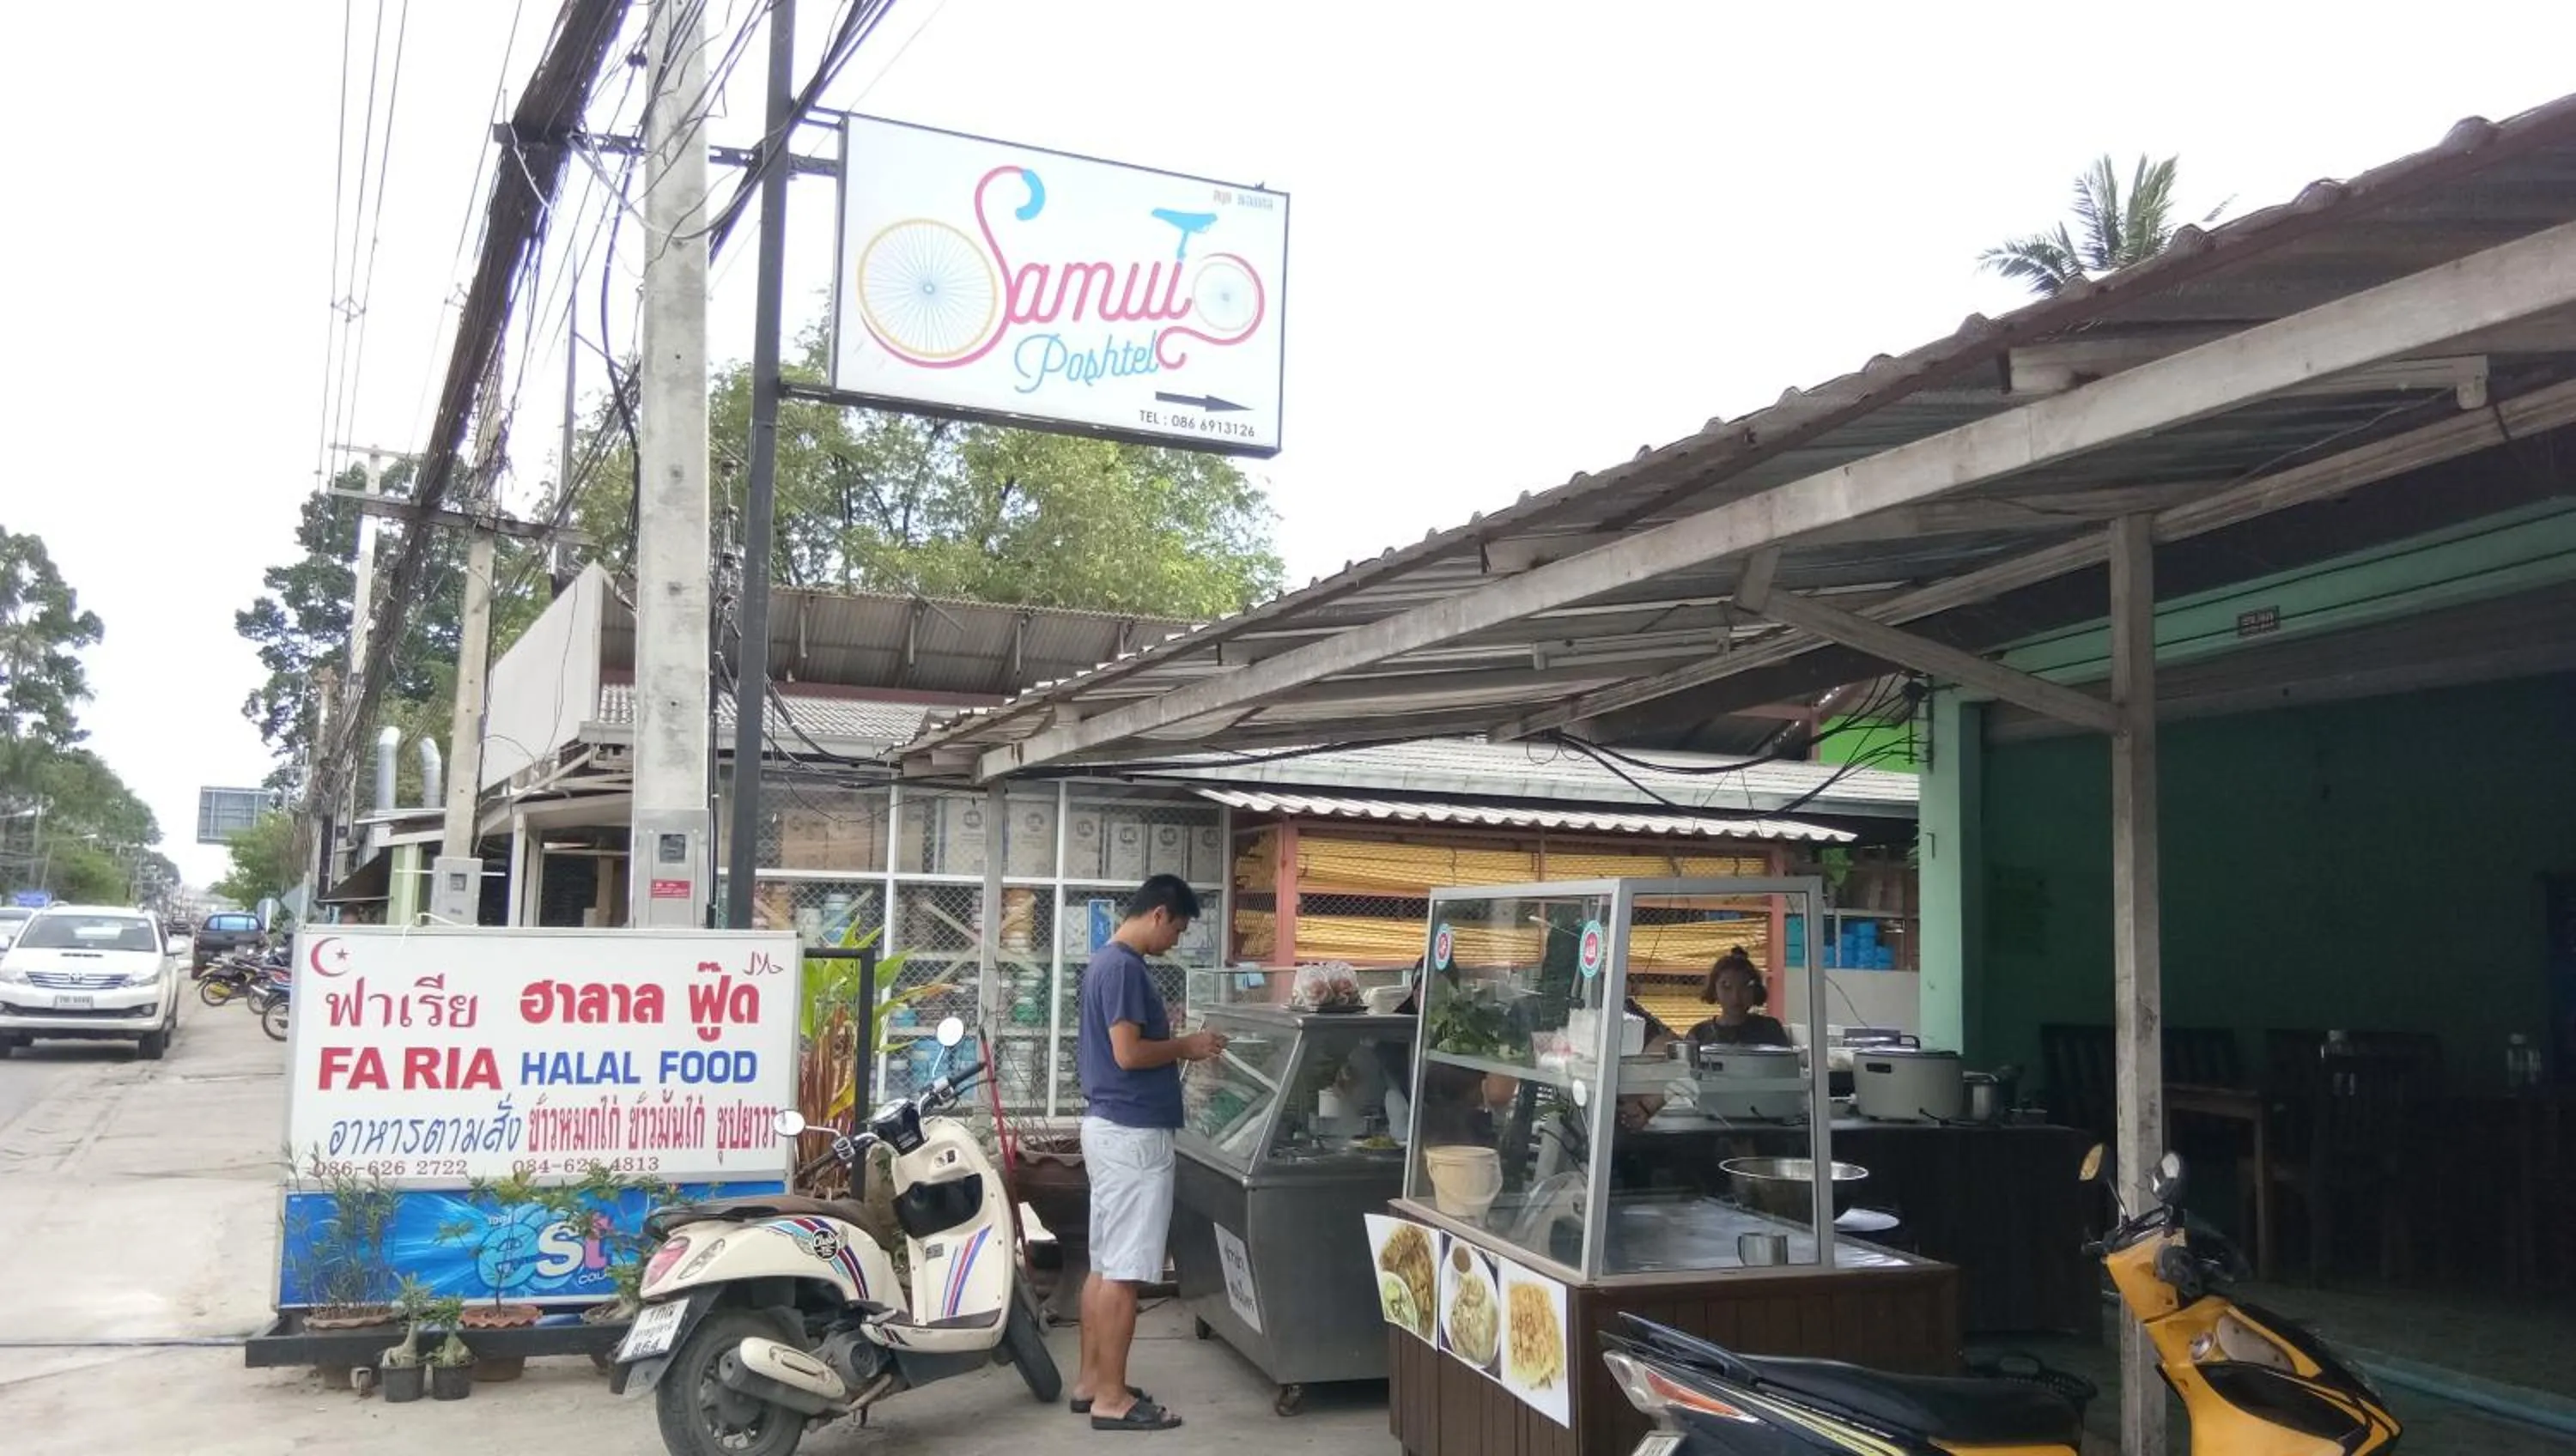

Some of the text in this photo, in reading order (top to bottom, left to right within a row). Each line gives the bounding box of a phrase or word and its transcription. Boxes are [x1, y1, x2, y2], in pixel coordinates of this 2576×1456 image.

[1014, 329, 1160, 393] Poshtel
[1171, 415, 1195, 429] 086
[1200, 419, 1255, 437] 6913126
[325, 972, 478, 1028] ฟาเรีย
[519, 978, 665, 1025] ฮาลาล
[519, 1048, 641, 1087] HALAL
[658, 1048, 762, 1086] FOOD
[328, 1092, 523, 1156] อาหารตามสั่ง
[314, 1159, 406, 1177] 086-626
[416, 1159, 469, 1175] 2722
[610, 1156, 659, 1172] 4813
[578, 1271, 607, 1286] COL
